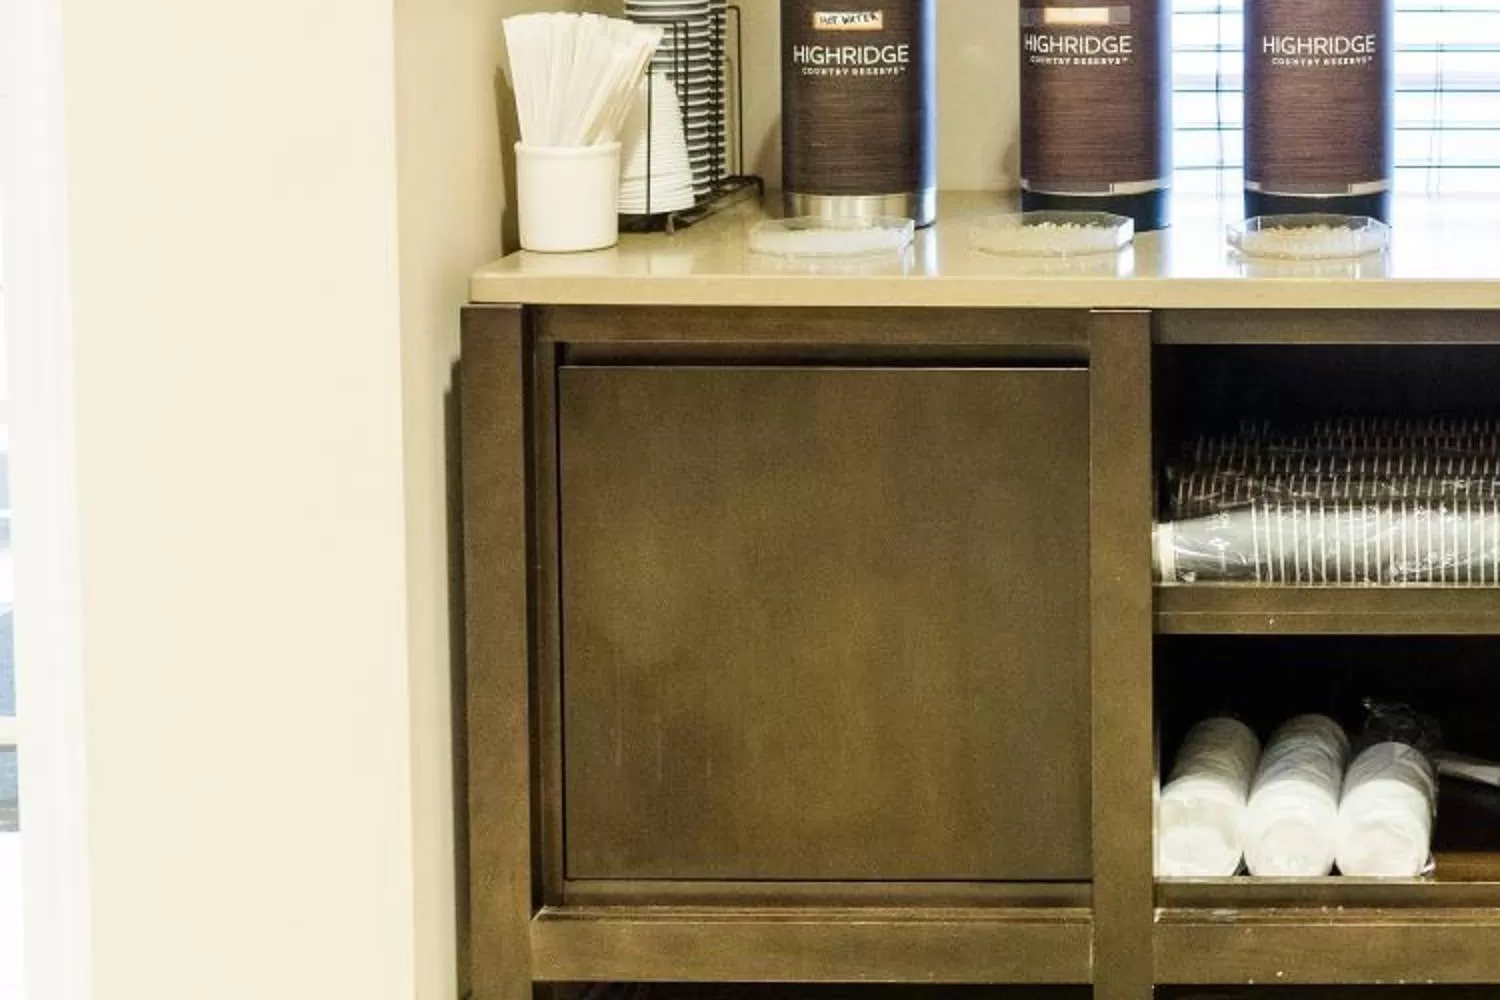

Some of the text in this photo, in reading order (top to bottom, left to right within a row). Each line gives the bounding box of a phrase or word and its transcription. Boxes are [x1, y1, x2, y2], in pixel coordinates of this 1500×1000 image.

[1024, 34, 1133, 55] HIGHRIDGE
[1263, 34, 1376, 55] HIGHRIDGE
[793, 45, 910, 65] HIGHRIDGE
[802, 67, 849, 76] COUNTRY
